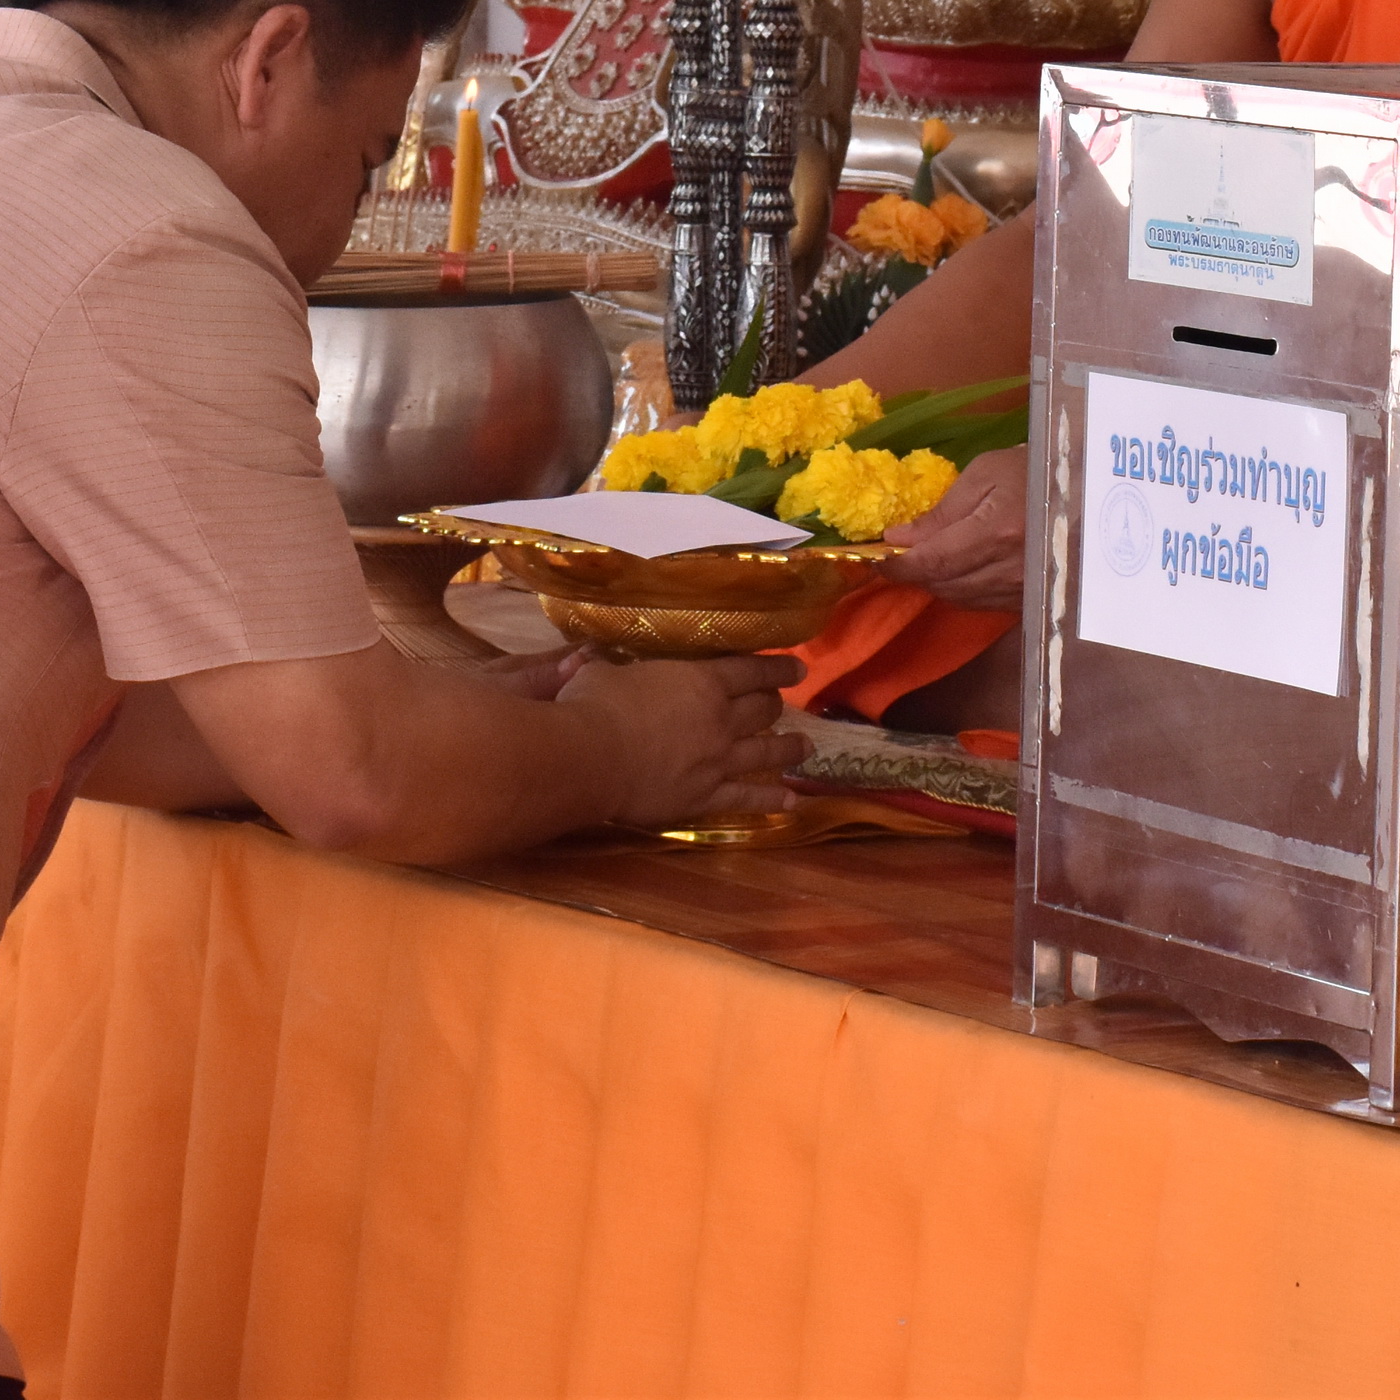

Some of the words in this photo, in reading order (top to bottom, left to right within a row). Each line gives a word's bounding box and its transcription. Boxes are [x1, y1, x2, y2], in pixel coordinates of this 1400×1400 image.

[1148, 226, 1294, 264] กองทุนพัฒนาและอนุรักษ์
[1110, 425, 1326, 527] ขอเชิญร่วมทำบุญ
[1162, 522, 1269, 590] ผูกข้อมือ
